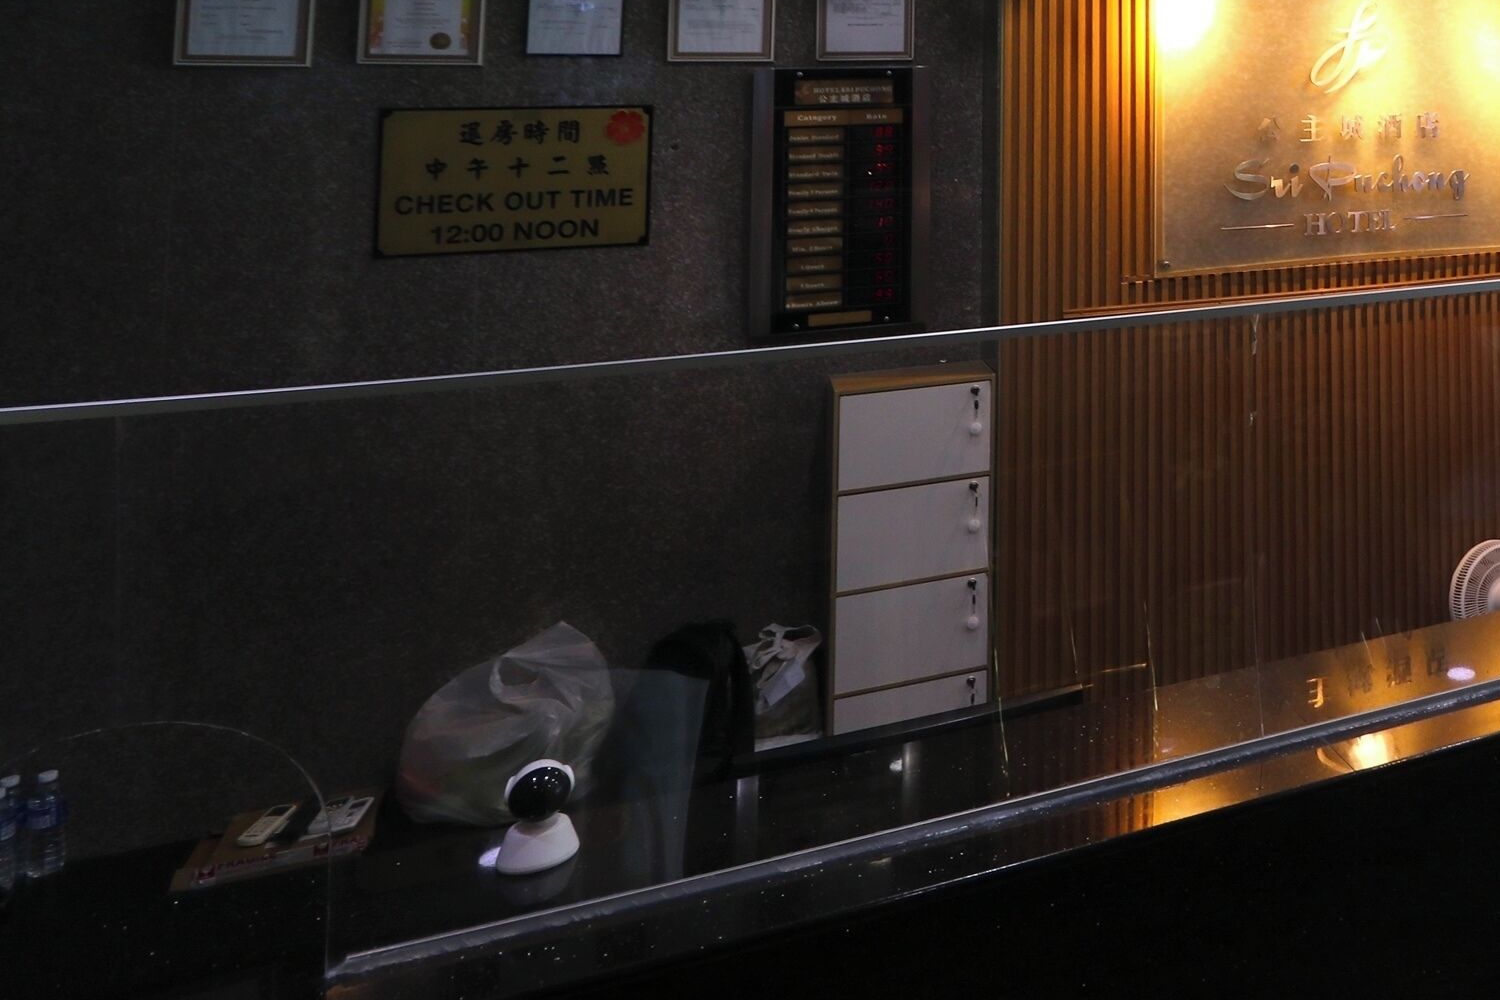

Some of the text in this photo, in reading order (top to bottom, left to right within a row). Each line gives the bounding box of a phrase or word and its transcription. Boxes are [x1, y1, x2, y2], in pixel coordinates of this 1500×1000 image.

[1224, 154, 1471, 201] Sri Puchong
[395, 188, 634, 216] CHECK OUT TIME
[432, 218, 600, 244] 12:00 NOON
[1303, 209, 1397, 237] HOTEL
